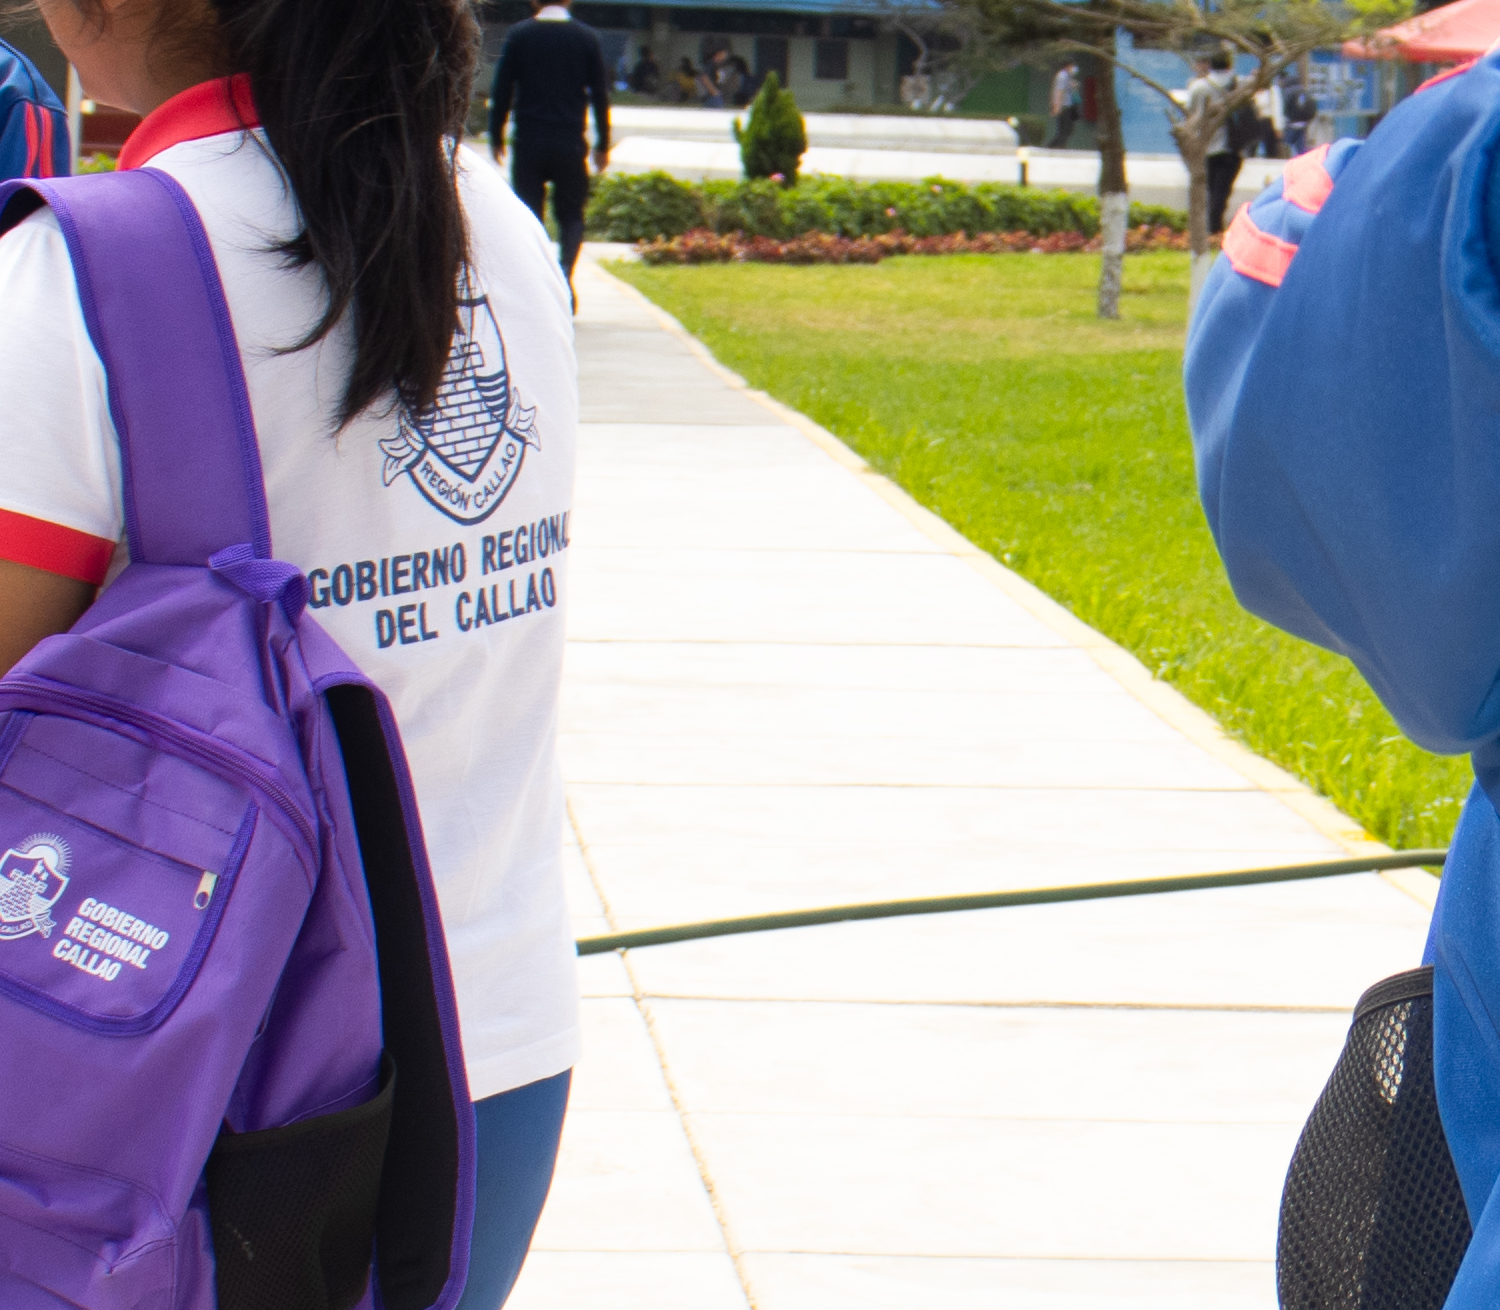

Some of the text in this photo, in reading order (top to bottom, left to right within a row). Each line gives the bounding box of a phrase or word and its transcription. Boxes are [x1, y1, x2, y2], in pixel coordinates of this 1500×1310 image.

[419, 442, 517, 510] REGIÓN CALLAO
[307, 542, 467, 609] GOBIERNO
[376, 566, 557, 648] DEL CALLAO
[64, 916, 151, 970] REGIONAL
[77, 897, 170, 951] GOBIERNO
[53, 938, 123, 981] CALLAO
